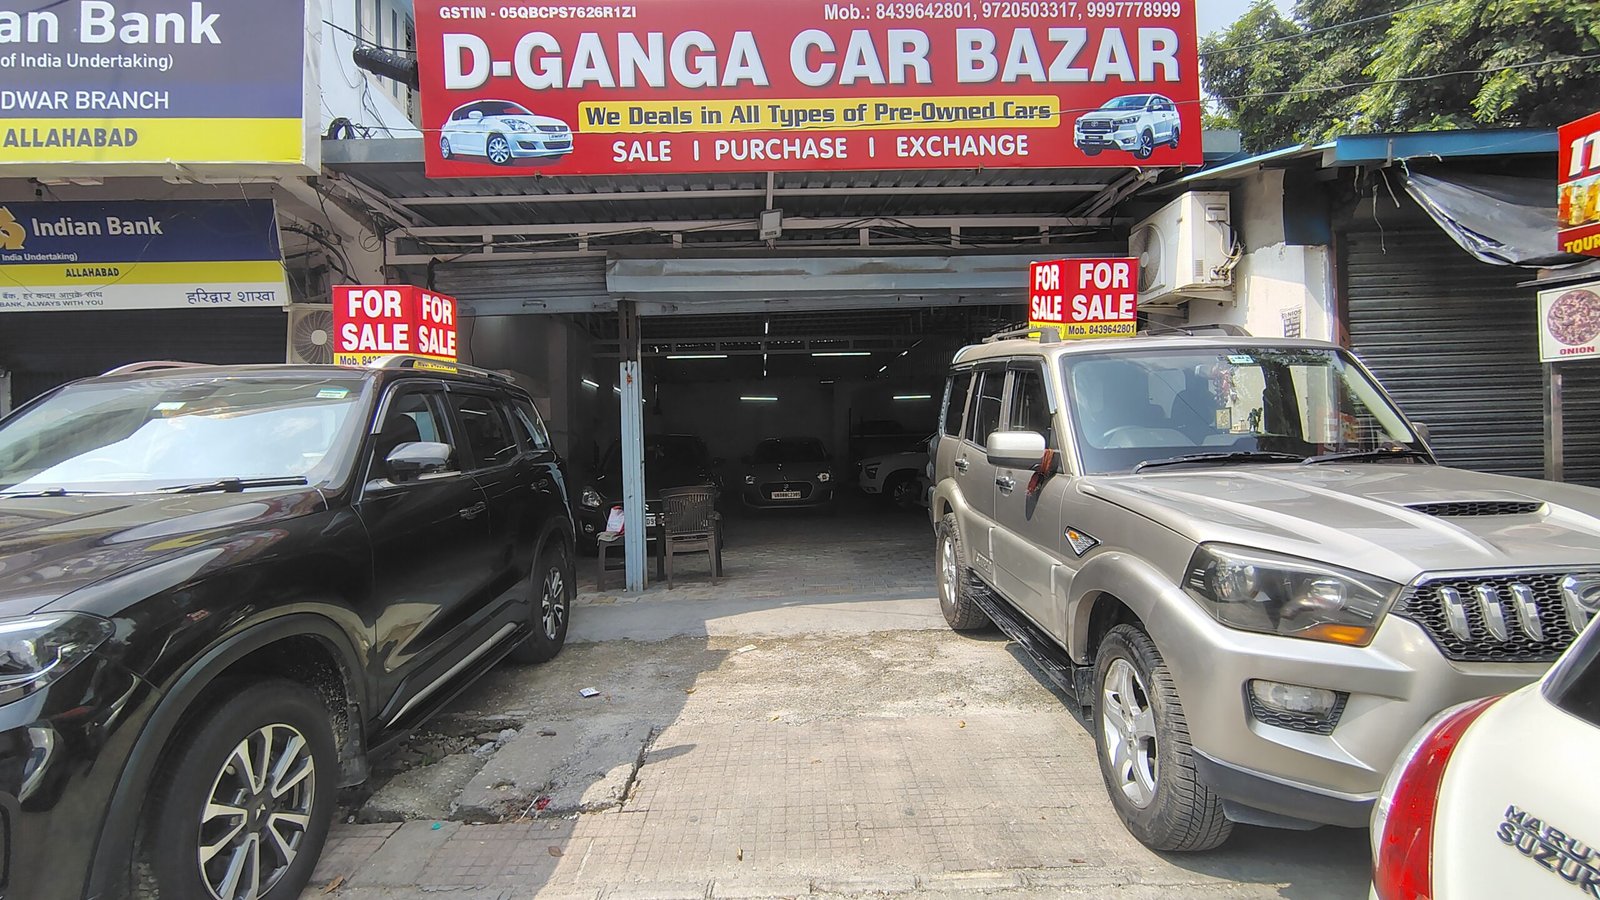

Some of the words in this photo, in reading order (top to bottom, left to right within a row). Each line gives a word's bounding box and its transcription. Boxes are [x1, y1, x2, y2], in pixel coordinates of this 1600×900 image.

[80, 1, 222, 44] Bank
[438, 7, 487, 19] GSTIN
[824, 4, 870, 20] Mob.:
[876, 2, 977, 21] 8439642801,
[982, 1, 1083, 20] 9720503317,
[1087, 1, 1182, 18] 9997778999
[0, 53, 17, 68] of
[21, 53, 61, 68] India
[67, 53, 173, 71] Undertaking)
[443, 31, 769, 90] D-GANGA
[789, 28, 932, 86] CAR
[956, 27, 1181, 83] BAZAR
[1, 91, 68, 110] DWAR
[75, 91, 169, 109] BRANCH
[586, 107, 620, 125] We
[629, 107, 692, 125] Deals
[701, 106, 722, 124] in
[730, 105, 759, 123] All
[768, 105, 835, 127] Types
[843, 103, 867, 122] of
[875, 101, 995, 121] Pre-Owned
[1003, 101, 1051, 119] Cars
[3, 128, 138, 147] ALLAHABAD
[612, 140, 672, 162] SALE
[715, 137, 847, 161] PURCHASE
[896, 134, 1029, 157] EXCHANGE
[32, 217, 102, 237] Indian
[106, 216, 163, 236] Bank
[1, 253, 23, 261] India
[24, 252, 78, 262] Undertaking)
[65, 267, 120, 277] ALLAHABAD
[1035, 264, 1060, 291] FOR
[1079, 262, 1130, 289] FOR
[185, 287, 232, 304] हरिद्वार
[237, 291, 275, 303] शाखा
[348, 289, 402, 318] FOR
[1071, 293, 1135, 321] SALE
[422, 293, 453, 325] FOR
[1031, 295, 1063, 321] SALE
[341, 323, 410, 351] SALE
[418, 325, 457, 356] SALE
[1068, 325, 1086, 335] Mob.
[1088, 323, 1136, 334] 8439642801
[340, 355, 360, 366] Mob.
[1559, 346, 1596, 355] ONION
